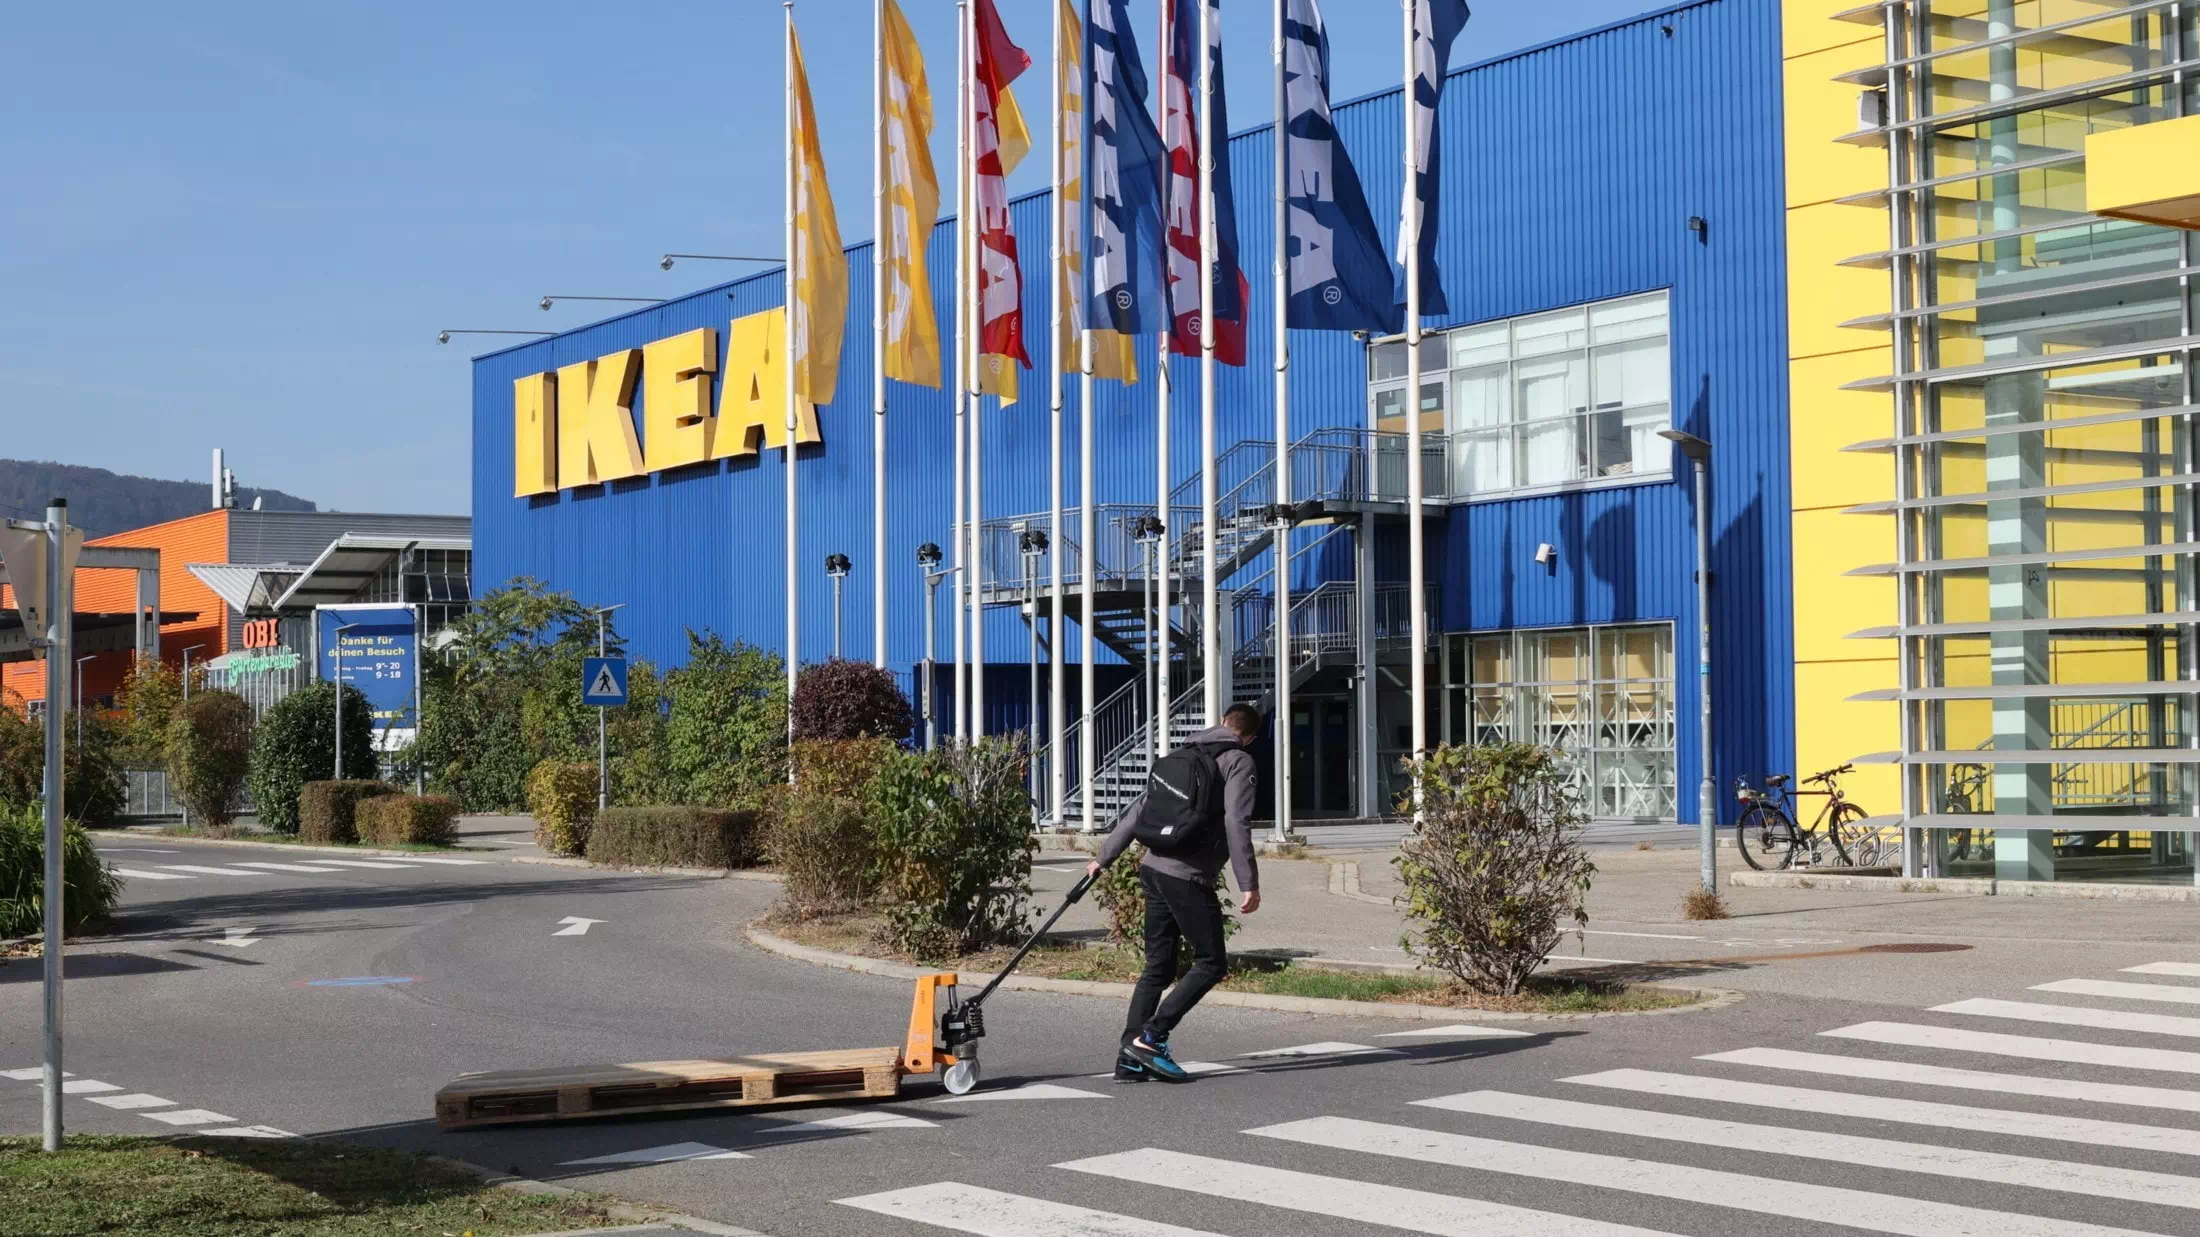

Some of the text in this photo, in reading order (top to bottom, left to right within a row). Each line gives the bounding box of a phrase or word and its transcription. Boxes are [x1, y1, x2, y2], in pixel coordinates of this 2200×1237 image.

[514, 305, 821, 498] IKEA
[242, 618, 278, 649] OBI
[340, 634, 394, 646] Danke für
[366, 647, 405, 656] Besuch
[389, 661, 401, 670] 20
[375, 670, 382, 679] 9
[389, 670, 401, 679] 18
